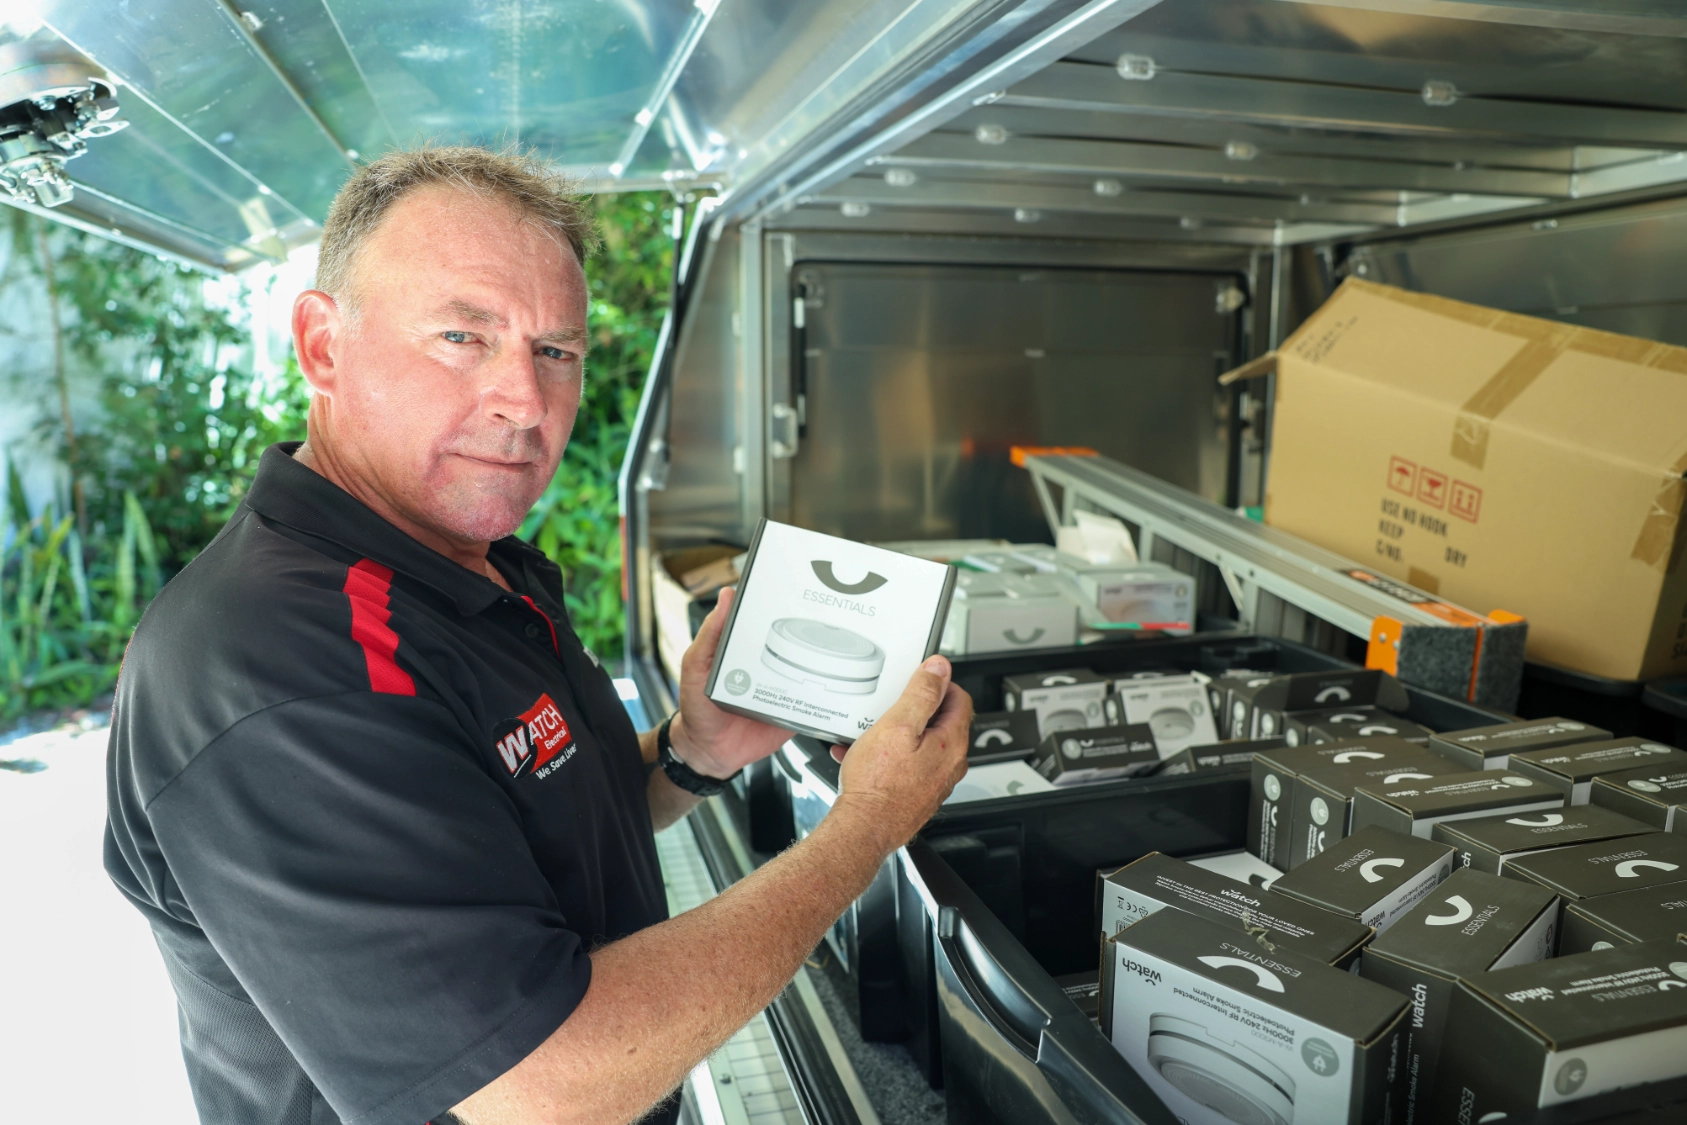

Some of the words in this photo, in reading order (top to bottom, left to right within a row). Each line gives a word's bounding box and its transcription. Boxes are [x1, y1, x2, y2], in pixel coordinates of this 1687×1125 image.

[1381, 498, 1400, 518] USE
[1402, 506, 1417, 525] NO
[1419, 512, 1448, 538] HOOK
[1379, 519, 1405, 540] KEEP
[1445, 546, 1468, 569] DRY
[803, 588, 876, 617] ESSENTIALS
[752, 694, 791, 710] Photoelectric
[792, 705, 812, 716] Smoke
[812, 711, 831, 721] Alarm
[754, 688, 778, 700] 3000Hz
[778, 695, 795, 704] 240V
[803, 702, 849, 719] Interconnected
[496, 704, 563, 774] WATCH
[544, 726, 567, 750] Electrical
[535, 766, 551, 780] We
[549, 754, 567, 771] Save
[1335, 848, 1374, 872] ESSENTIALS
[1587, 849, 1649, 865] ESSENTIALS
[1221, 889, 1260, 907] watch
[1258, 911, 1275, 921] YOUR
[1275, 918, 1296, 929] LOVED
[1296, 926, 1315, 936] ONES
[1461, 905, 1500, 935] ESSENTIALS
[1122, 957, 1162, 985] watch
[1219, 942, 1302, 978] ESSENTIALS
[1173, 987, 1227, 1018] Interconnected
[1192, 987, 1215, 1002] Alarm
[1215, 994, 1242, 1011] Smoke
[1411, 983, 1428, 1028] watch
[1504, 987, 1553, 1003] watch
[1228, 1012, 1239, 1022] RF
[1240, 1016, 1261, 1031] 240V
[1243, 1007, 1295, 1036] Photoelectric
[1262, 1025, 1294, 1044] 3000Hz
[1410, 1054, 1420, 1077] Alarm
[1408, 1077, 1417, 1101] Smoke
